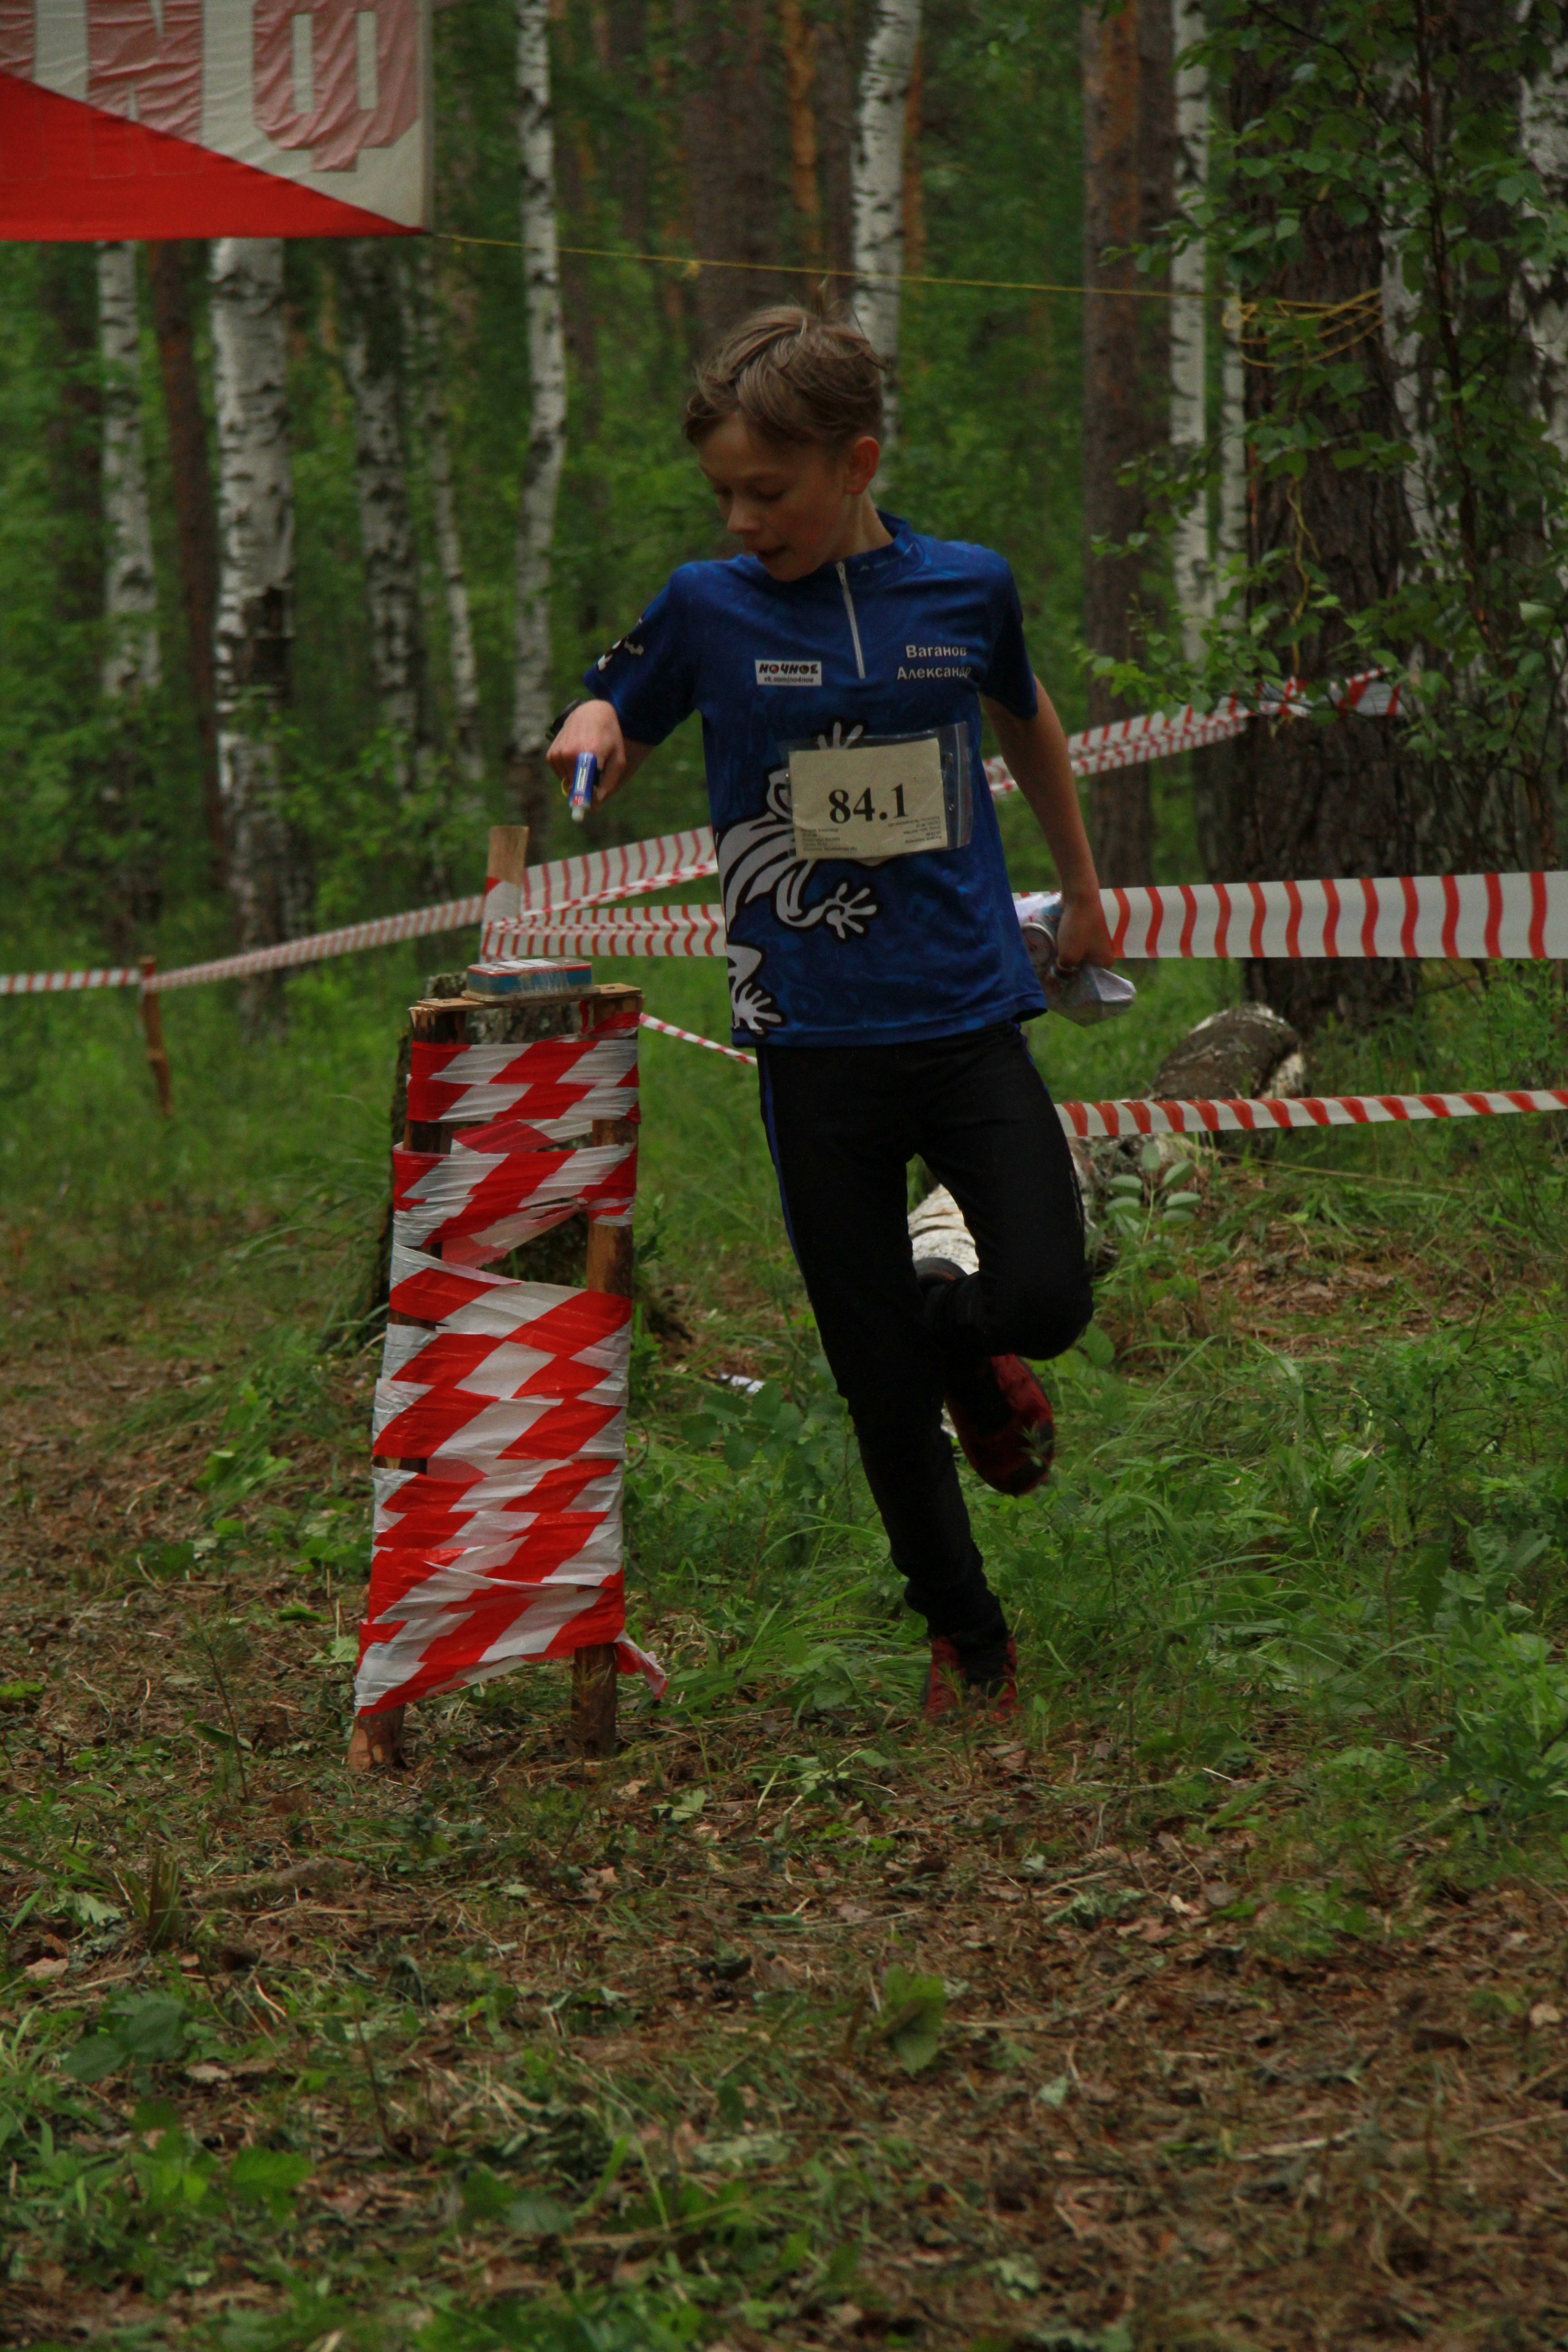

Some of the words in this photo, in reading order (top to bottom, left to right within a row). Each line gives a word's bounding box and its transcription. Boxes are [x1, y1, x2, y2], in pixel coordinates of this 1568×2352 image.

[905, 644, 967, 658] Ваганов
[758, 663, 819, 674] НОЧНОЕ
[897, 666, 971, 680] Александр
[828, 783, 910, 824] 84.1
